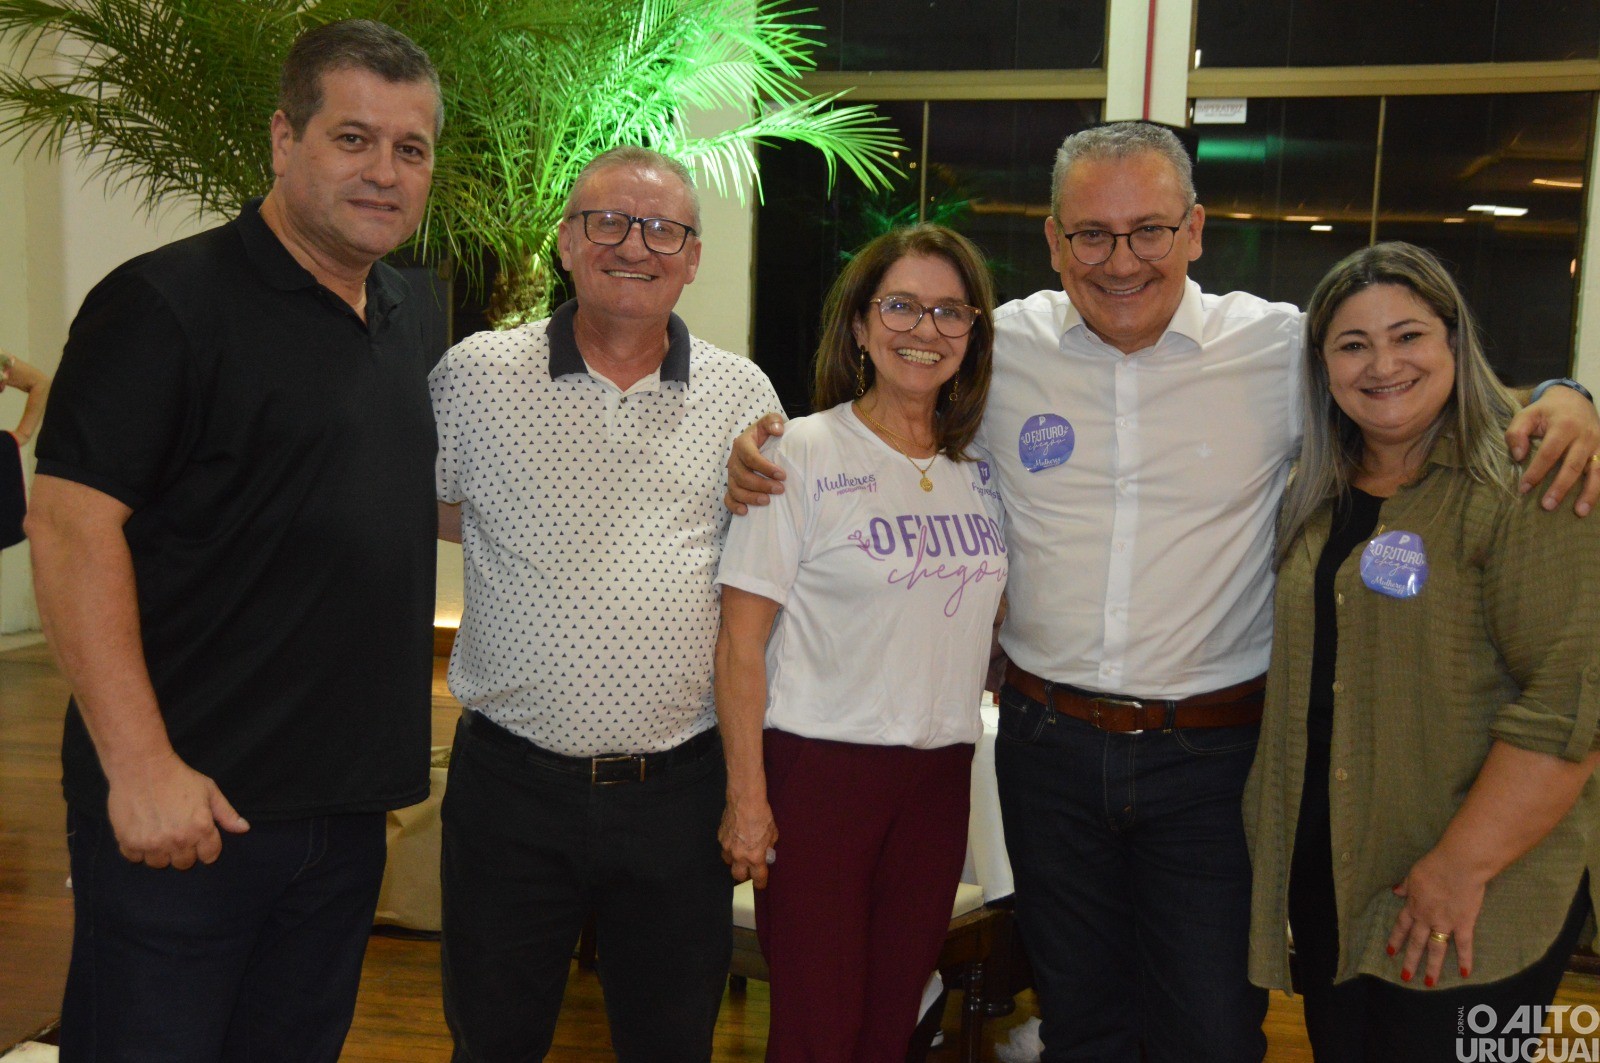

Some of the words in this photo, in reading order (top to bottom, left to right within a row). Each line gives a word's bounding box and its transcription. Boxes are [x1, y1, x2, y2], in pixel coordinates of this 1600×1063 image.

[1025, 432, 1031, 444] O
[1031, 424, 1064, 443] FUTURO
[814, 473, 876, 501] Mulheres
[866, 481, 878, 494] 11
[869, 516, 896, 555] O
[896, 513, 1007, 558] FUTURO
[1375, 543, 1383, 556] O
[1382, 545, 1424, 565] FUTURO
